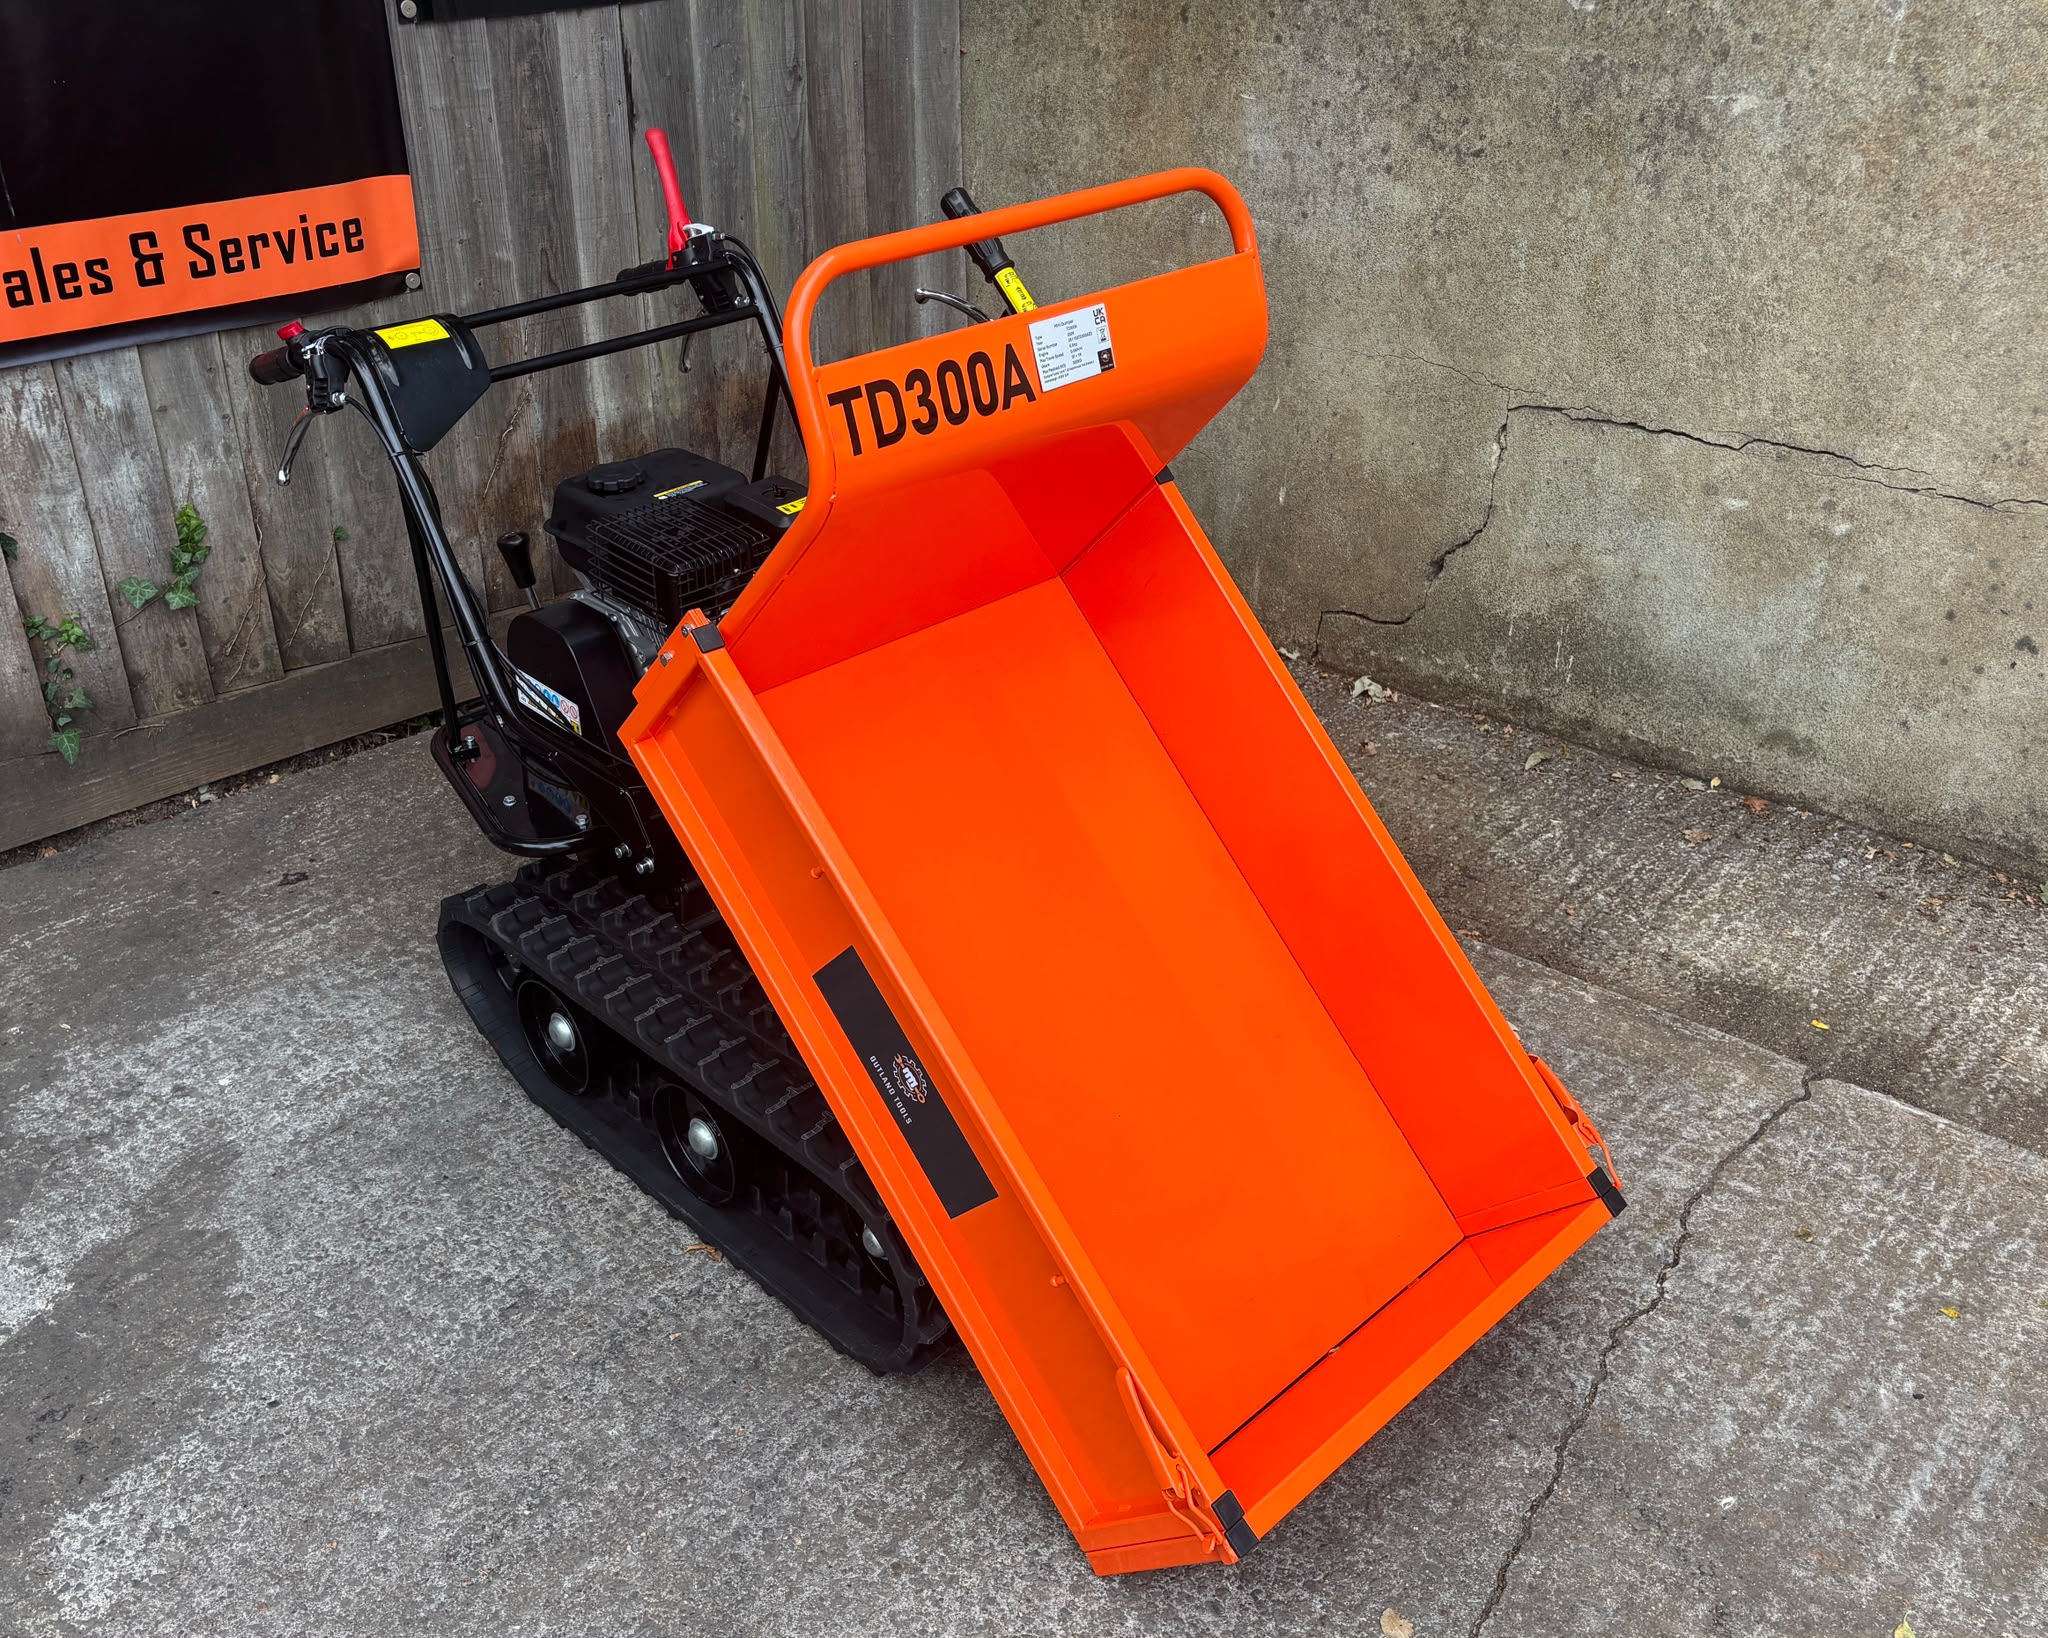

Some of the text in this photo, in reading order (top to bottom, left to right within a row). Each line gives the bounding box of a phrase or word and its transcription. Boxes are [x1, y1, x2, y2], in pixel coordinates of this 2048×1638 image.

[2, 214, 364, 309] ales & Service
[827, 343, 1037, 457] TD300A
[869, 1055, 913, 1124] OUTLAND TOOLS
